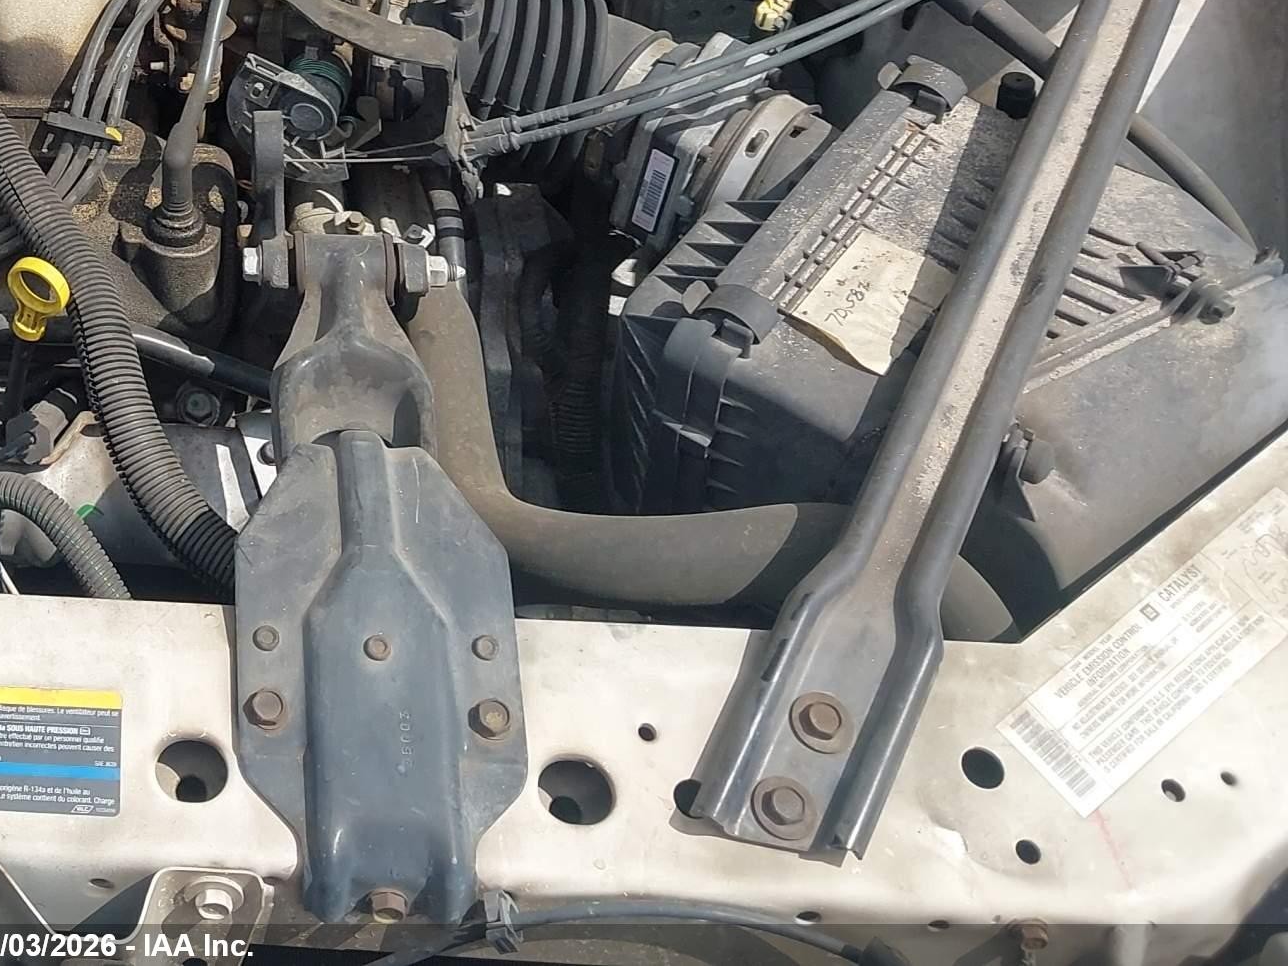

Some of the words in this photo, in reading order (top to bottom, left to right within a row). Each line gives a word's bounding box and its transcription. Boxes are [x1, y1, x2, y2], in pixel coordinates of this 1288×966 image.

[1156, 563, 1203, 603] CATALYST
[1053, 670, 1086, 700] VEHICLE
[1080, 645, 1115, 676] EMISSION
[1110, 621, 1144, 650] CONTROL
[1084, 645, 1132, 688] INFORMATION
[6, 723, 24, 731] SOUS
[25, 724, 45, 732] HAUTE
[46, 725, 78, 734] PRESSION
[44, 734, 52, 742] un
[53, 735, 81, 743] personnel
[23, 785, 45, 794] R-134a
[46, 786, 53, 794] et
[82, 788, 90, 796] au
[32, 793, 56, 802] contient
[58, 795, 65, 803] du
[93, 797, 114, 805] Charge
